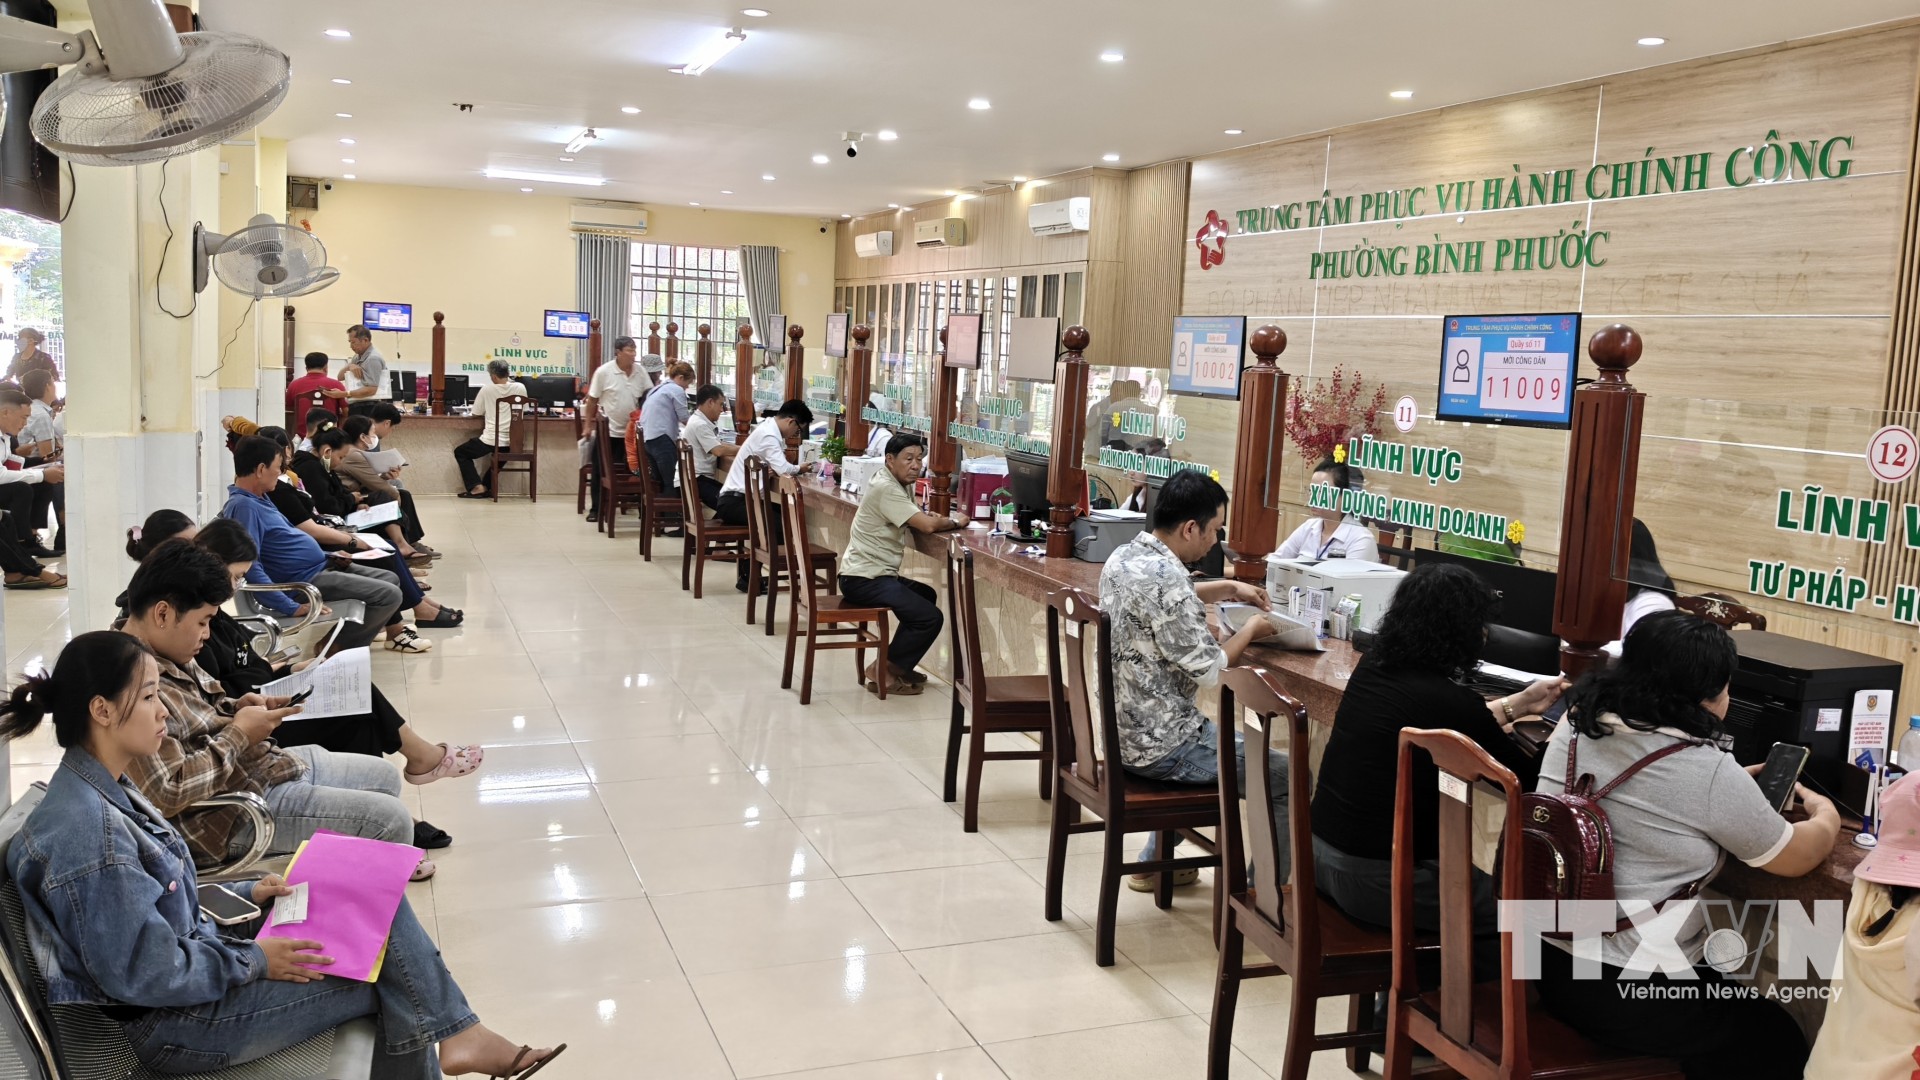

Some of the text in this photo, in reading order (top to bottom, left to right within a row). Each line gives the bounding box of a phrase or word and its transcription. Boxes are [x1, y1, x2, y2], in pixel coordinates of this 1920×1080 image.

[1236, 129, 1855, 234] TRUNG TÂM PHỤC VỤ HÀNH CHÍNH CÔNG
[1309, 220, 1611, 279] PHƯỜNG BÌNH PHƯỚC
[494, 346, 548, 360] LĨNH VỰC
[1510, 340, 1525, 349] Quầy
[561, 366, 575, 374] ĐAI
[1195, 361, 1234, 380] 10002
[1503, 356, 1546, 365] MỜI CÔNG DÂN
[1151, 385, 1159, 398] 10
[1486, 376, 1560, 401] 11009
[980, 395, 1023, 421] LĨNH VỰC
[1398, 406, 1413, 422] 11
[1121, 408, 1186, 444] LĨNH VỰC
[1099, 445, 1118, 468] XÂY
[1144, 454, 1170, 478] KINH
[1348, 434, 1463, 486] LĨNH VỰC
[1878, 442, 1909, 467] 12
[1308, 480, 1506, 544] XÂY DỰNG KINH DOANH
[1775, 484, 1890, 544] LĨNH
[1748, 558, 1785, 598] TƯ
[1786, 566, 1867, 613] PHÁP
[1893, 584, 1920, 624] H
